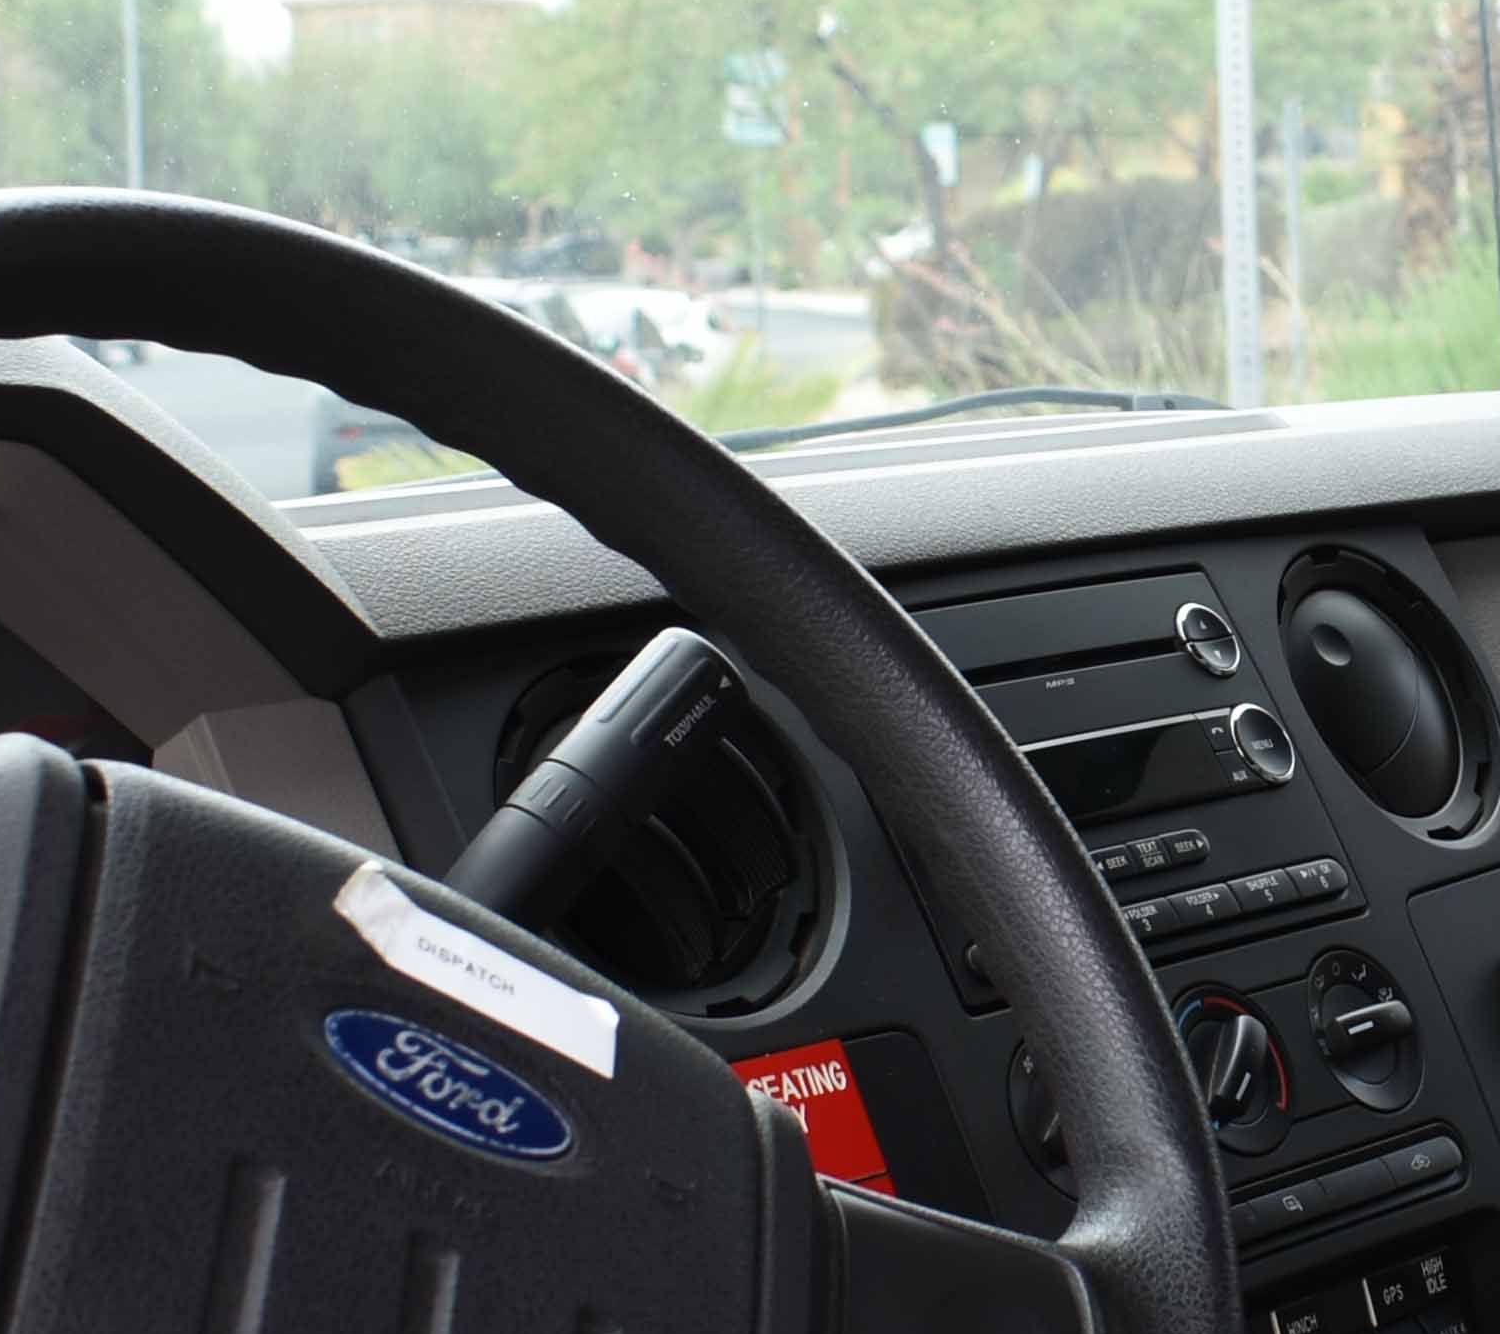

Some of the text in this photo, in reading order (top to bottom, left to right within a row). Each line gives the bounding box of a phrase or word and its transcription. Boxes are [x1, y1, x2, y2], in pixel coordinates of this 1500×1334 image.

[1251, 738, 1274, 751] MENU
[1136, 841, 1158, 855] TEXT
[1173, 841, 1196, 853] SEEK
[1105, 855, 1128, 869] SEEK
[1142, 854, 1165, 868] SCAN
[1319, 875, 1330, 889] 6
[1263, 889, 1274, 903] 5
[1205, 903, 1214, 916] 4
[1142, 918, 1152, 932] 3
[417, 936, 515, 996] DISPATCH
[376, 1029, 525, 1134] Ford
[1420, 1255, 1443, 1277] HIGH
[1425, 1273, 1448, 1295] IDLE
[1382, 1284, 1404, 1306] GPS
